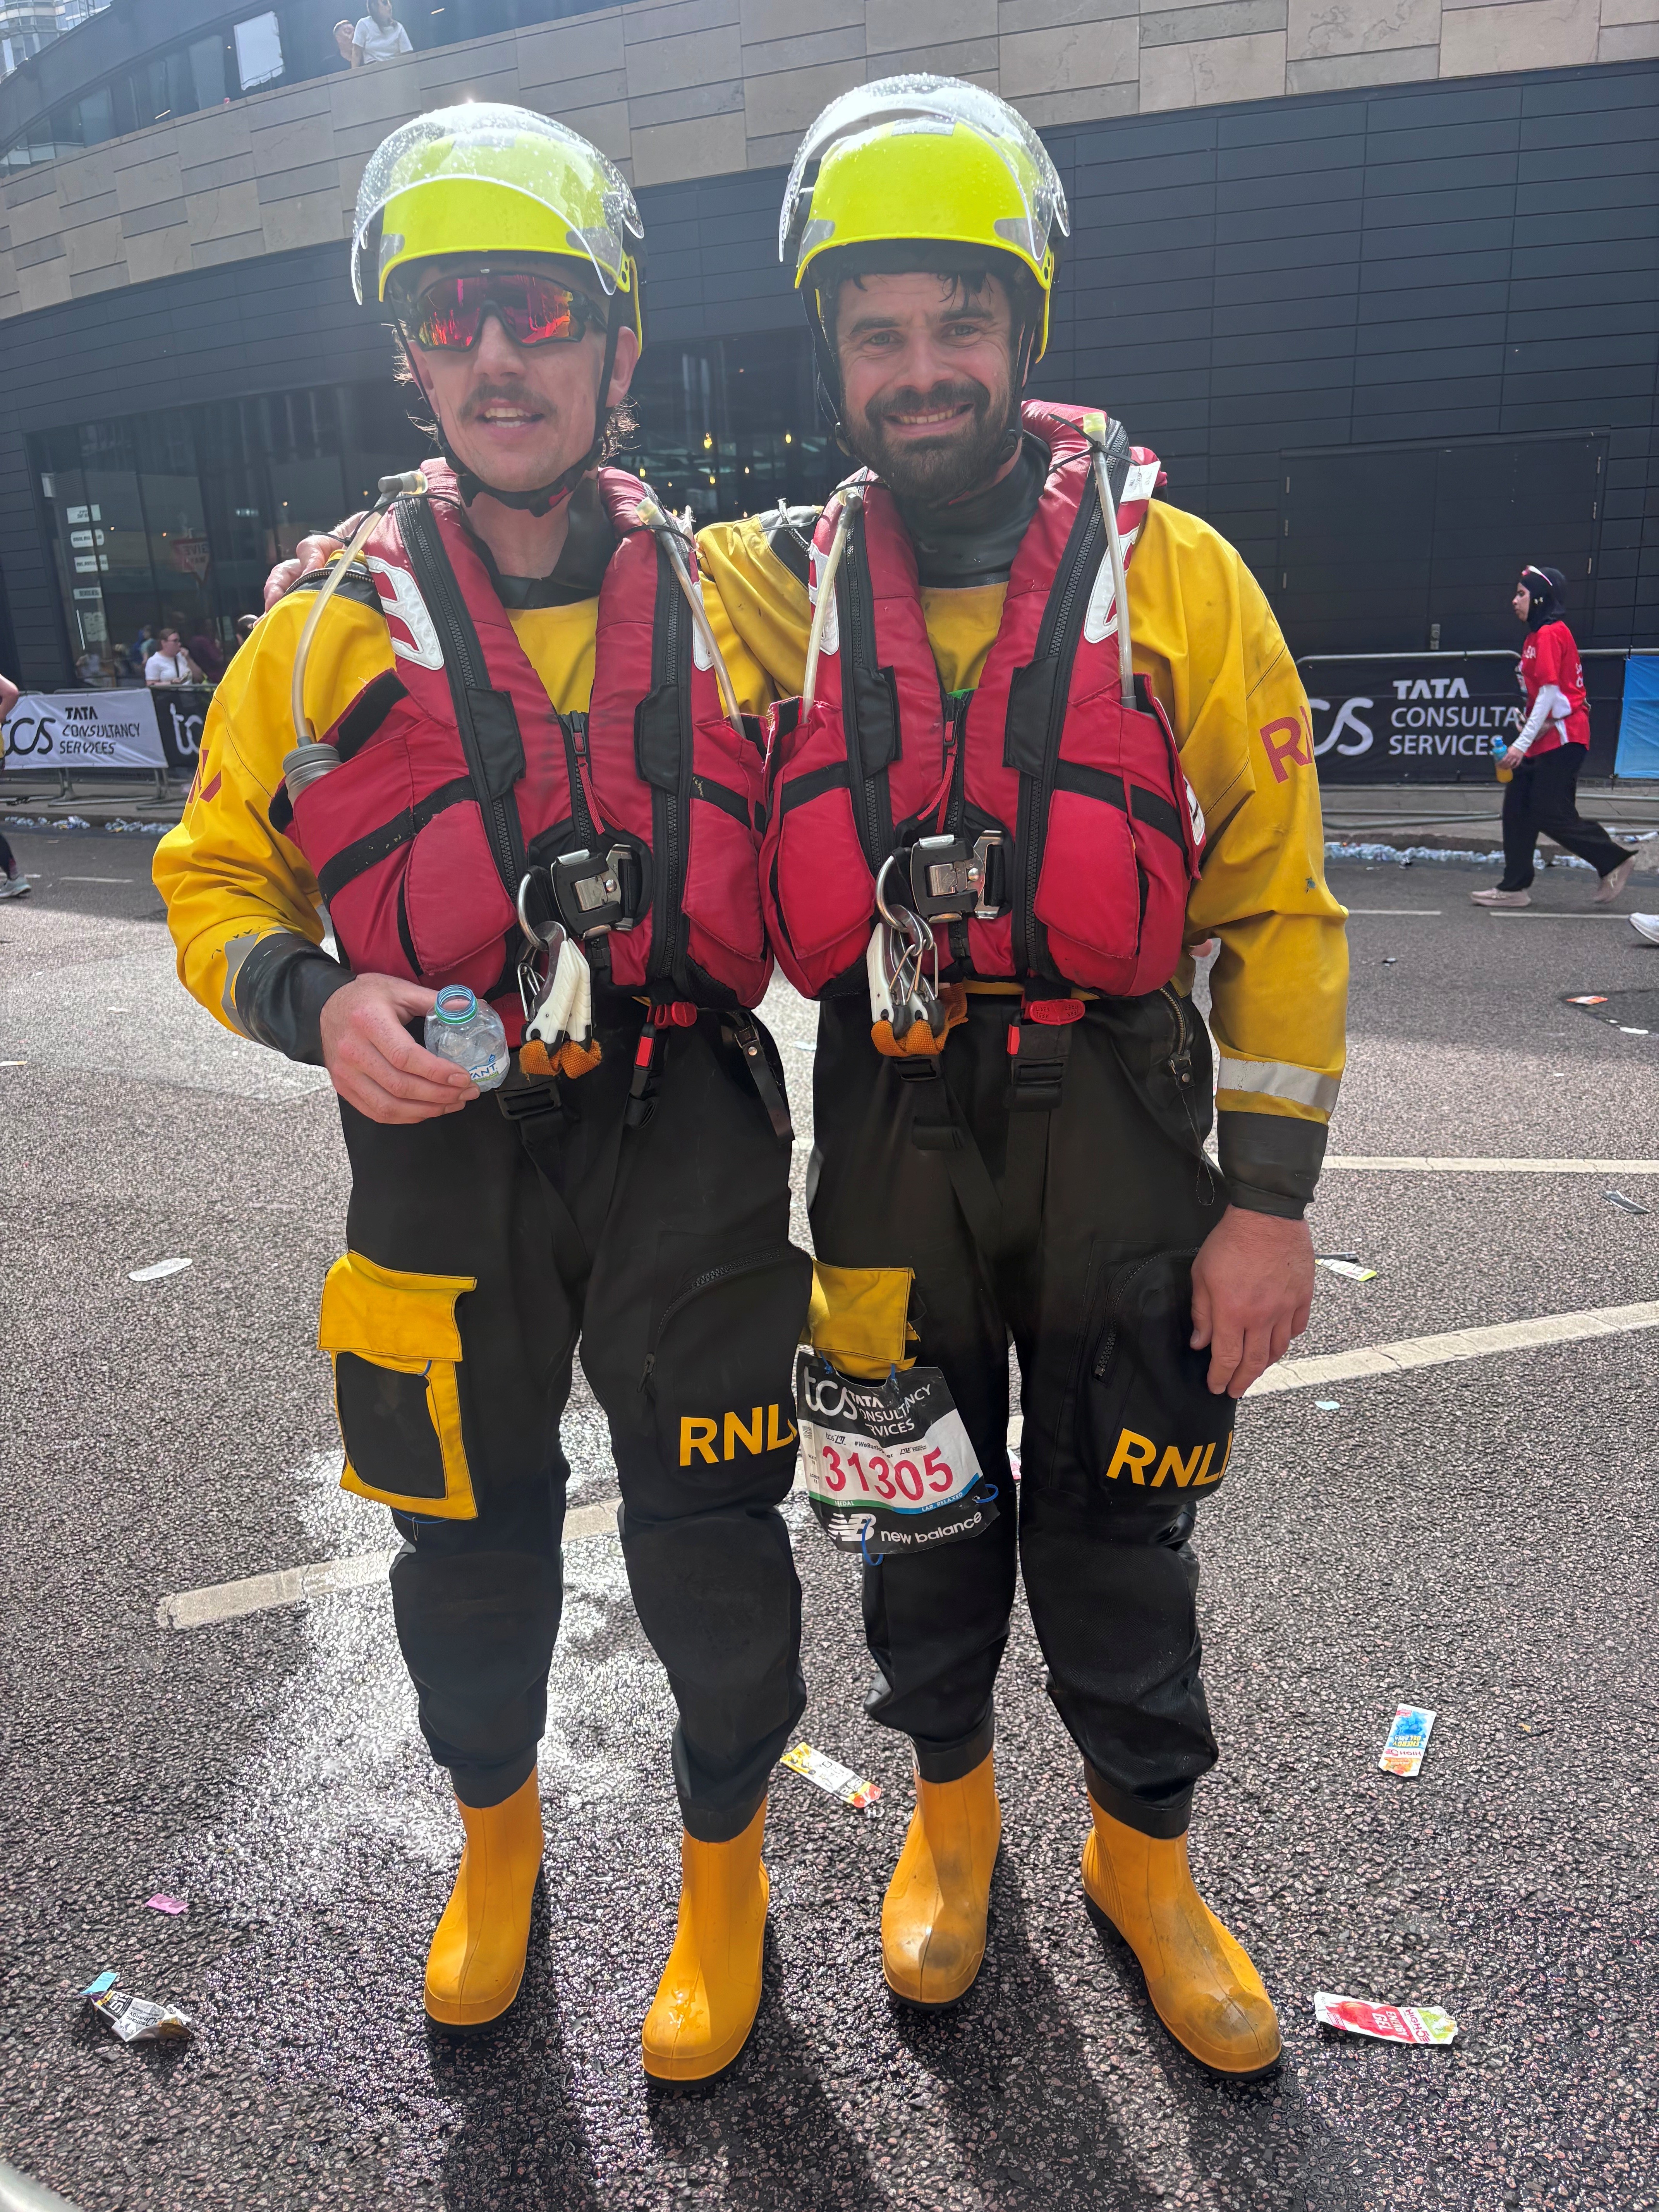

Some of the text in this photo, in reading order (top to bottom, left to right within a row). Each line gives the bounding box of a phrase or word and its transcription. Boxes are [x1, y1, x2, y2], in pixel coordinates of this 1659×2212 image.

[1393, 678, 1470, 700] TATA
[65, 707, 98, 720] TATA
[1391, 706, 1525, 728] CONSULTA
[62, 723, 140, 738] CONSULTANCY
[60, 740, 117, 754] SERVICES
[471, 1063, 496, 1079] ANT
[804, 1366, 857, 1420] tcs
[858, 1384, 931, 1422] ONSULTANCY
[865, 1418, 915, 1436] RVICES
[823, 1446, 953, 1501] 31305
[936, 1492, 963, 1506] RELAXED
[881, 1511, 982, 1544] new balance
[1372, 2013, 1393, 2030] GEL
[1386, 2010, 1410, 2037] ENERGY
